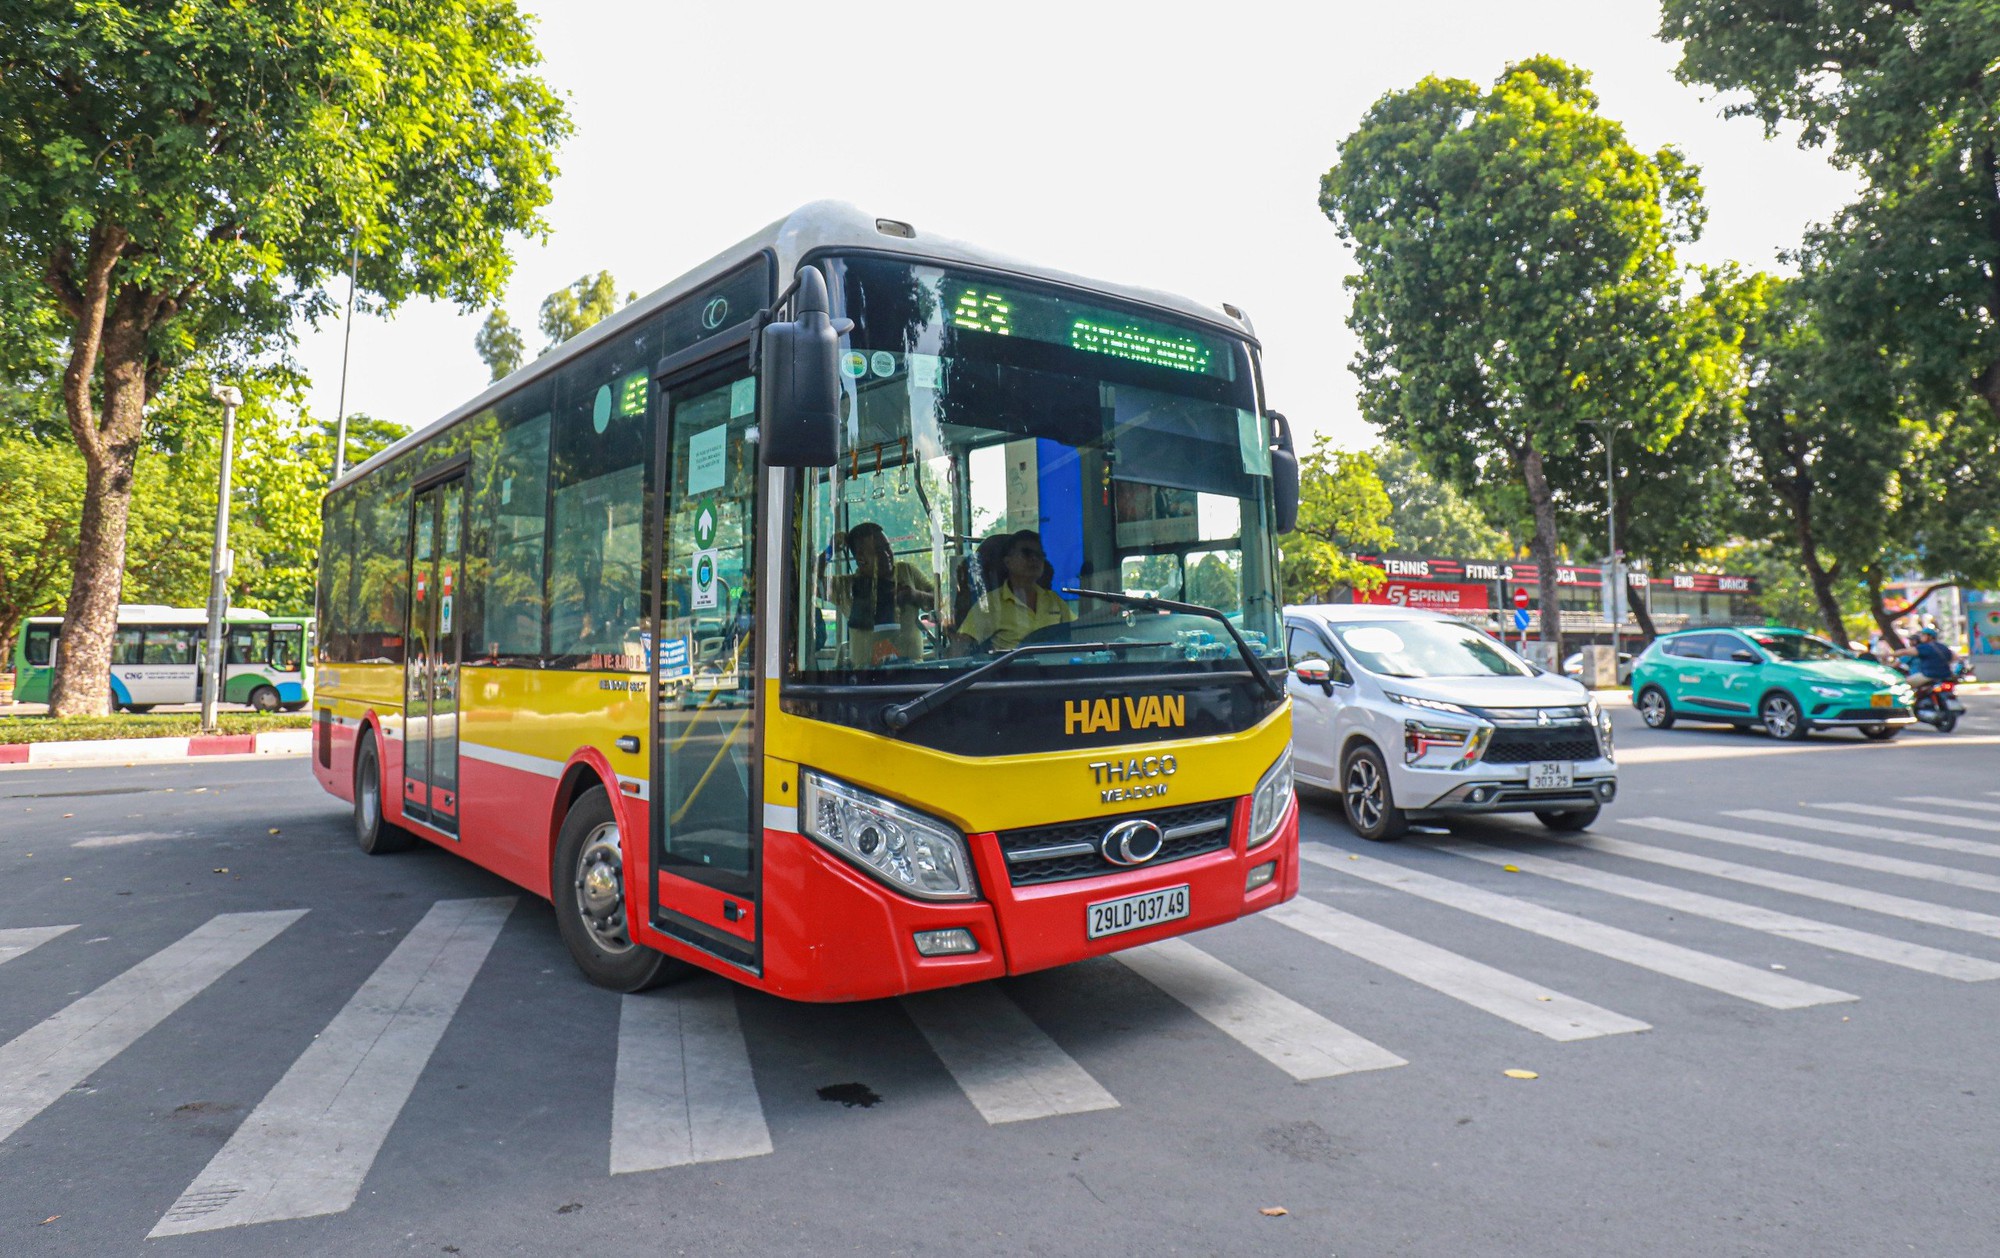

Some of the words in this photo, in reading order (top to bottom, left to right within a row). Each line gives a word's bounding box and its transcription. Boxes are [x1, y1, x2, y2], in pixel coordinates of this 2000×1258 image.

[1382, 559, 1430, 575] TENNIS
[1465, 564, 1514, 581] FITNES
[1673, 575, 1695, 589] EMS
[1718, 577, 1749, 591] DANCE
[1408, 588, 1460, 603] SPRING
[124, 672, 142, 680] CNG
[1065, 698, 1120, 735] HAI
[1123, 694, 1185, 729] VAN
[1089, 754, 1177, 785] THACO
[1541, 763, 1562, 775] 35A
[1101, 783, 1167, 804] MEADOW
[1094, 891, 1185, 933] 29LD-037.49
